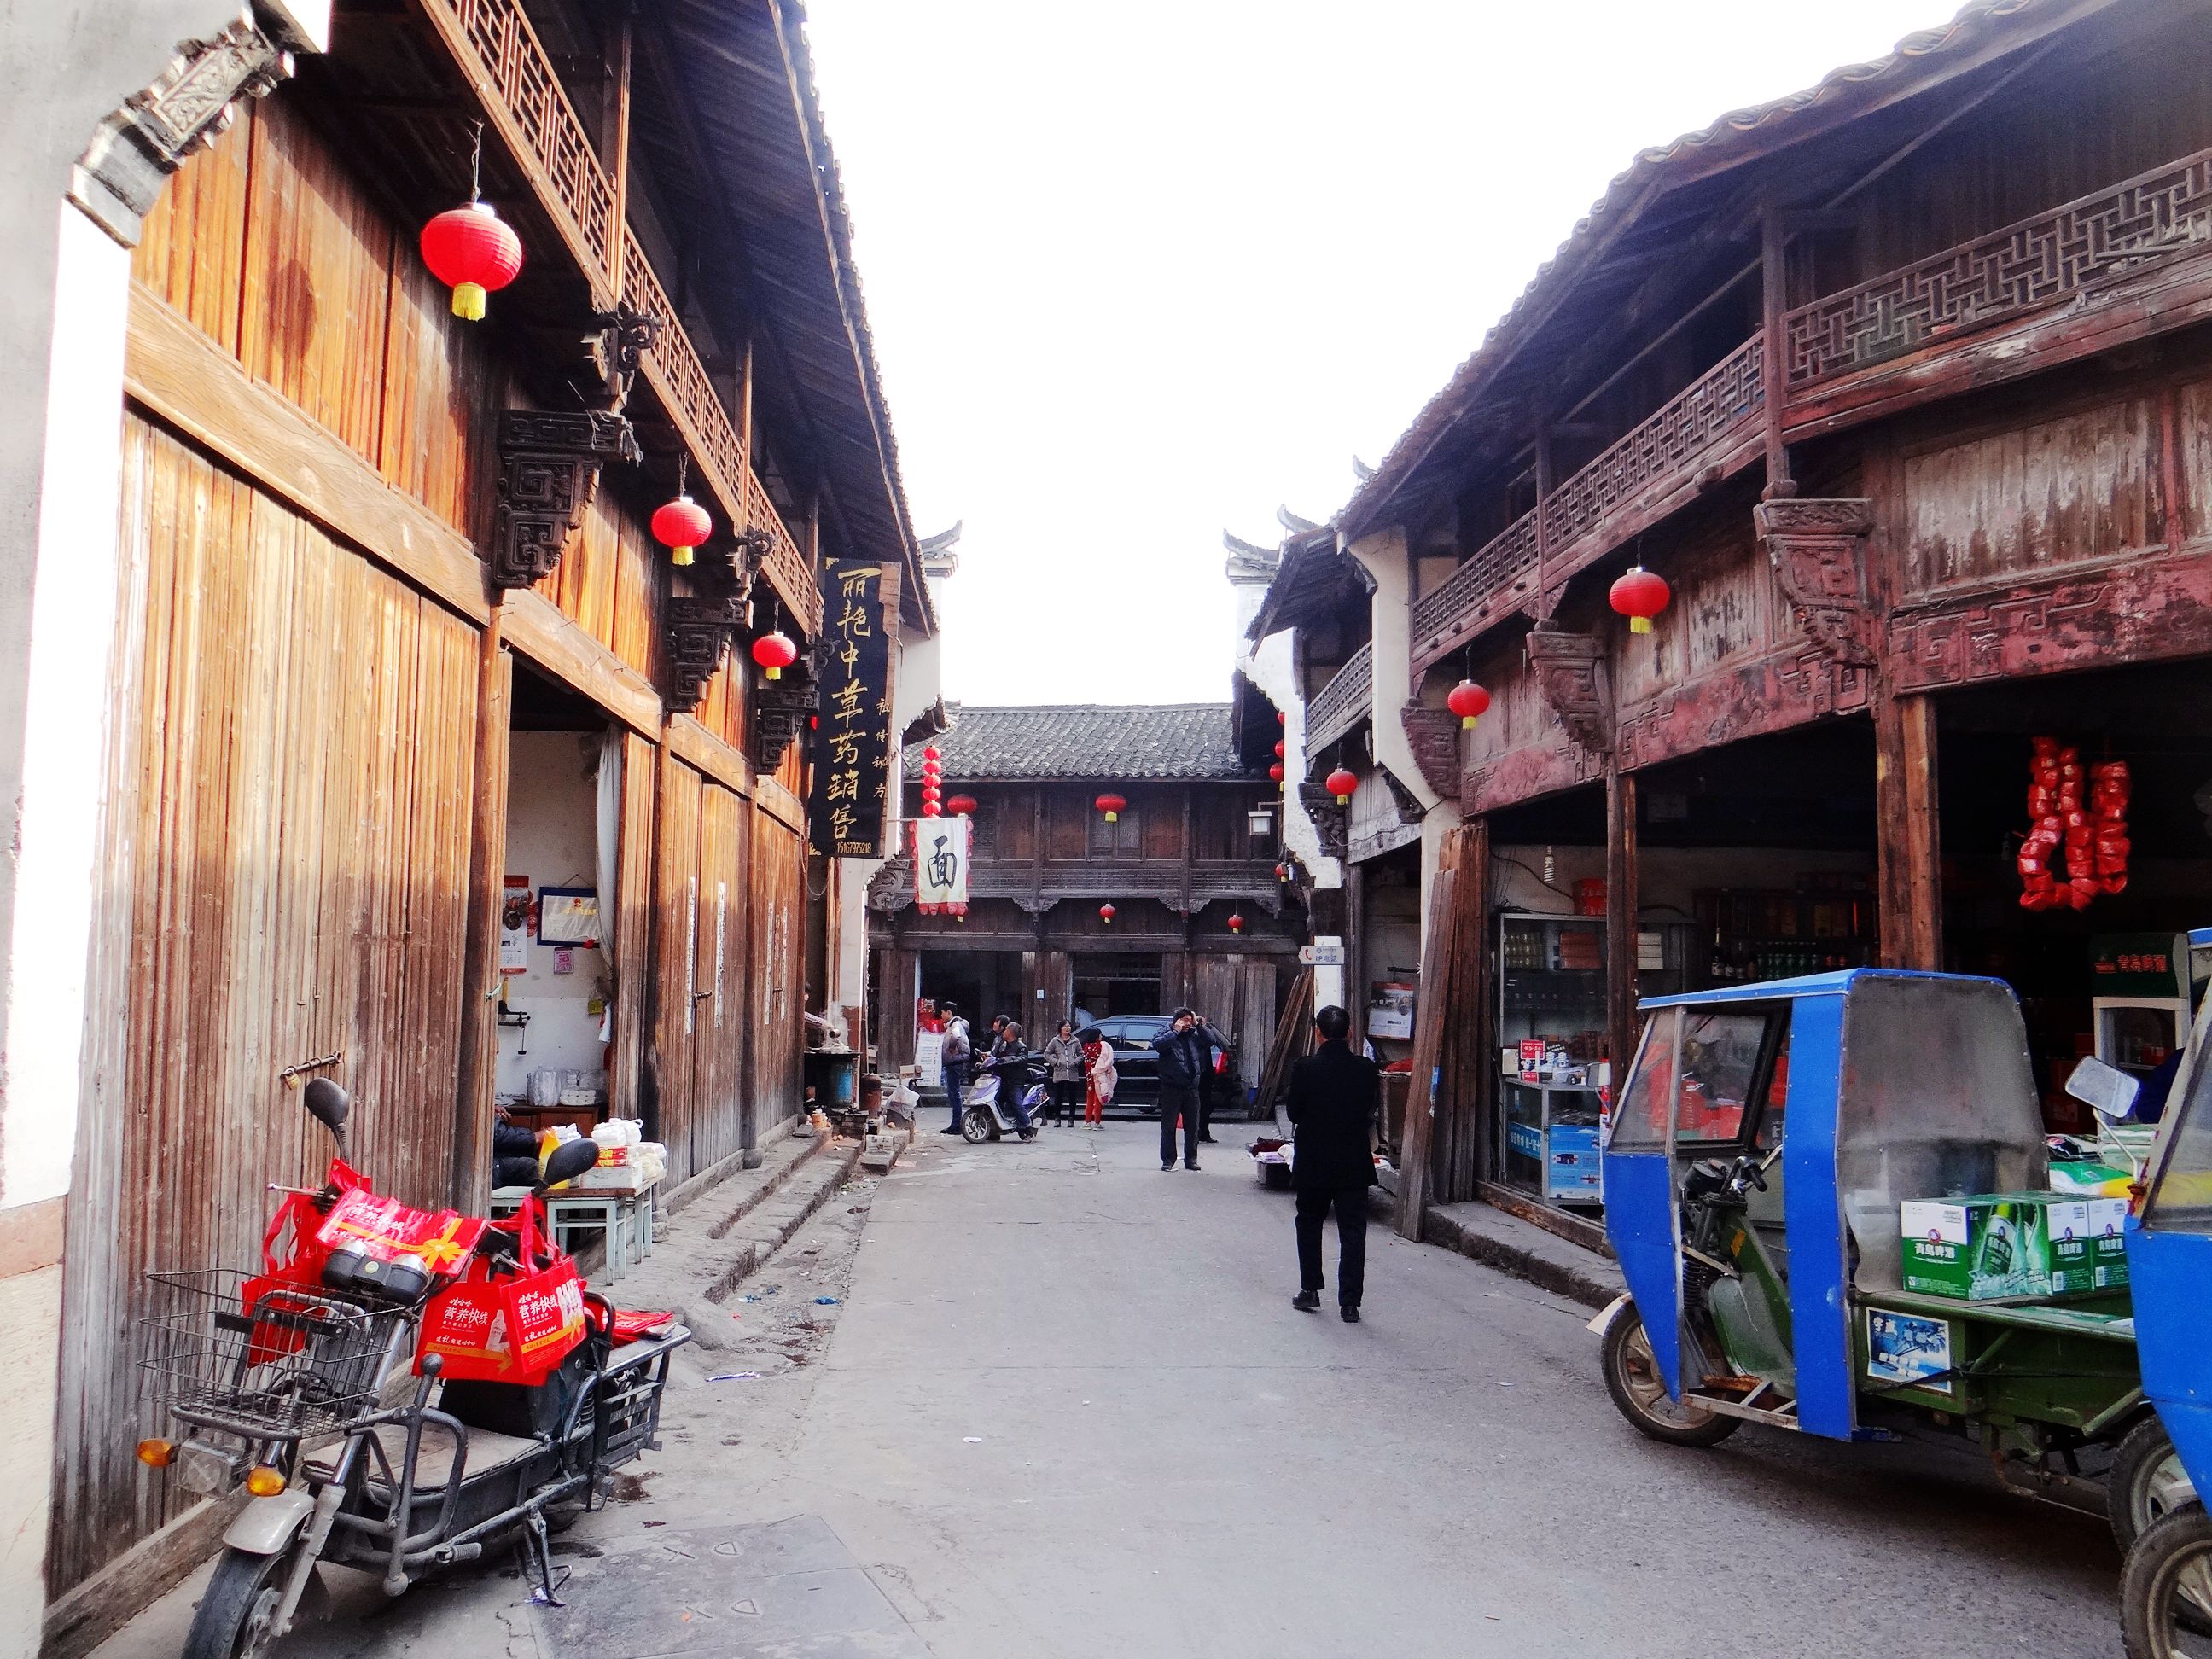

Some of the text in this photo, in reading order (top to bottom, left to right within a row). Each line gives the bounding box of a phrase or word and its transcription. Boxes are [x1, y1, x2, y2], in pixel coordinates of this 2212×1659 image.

[871, 698, 891, 799] 祖传秘方
[444, 1306, 489, 1326] 营养快线
[519, 1294, 558, 1319] 营养快线
